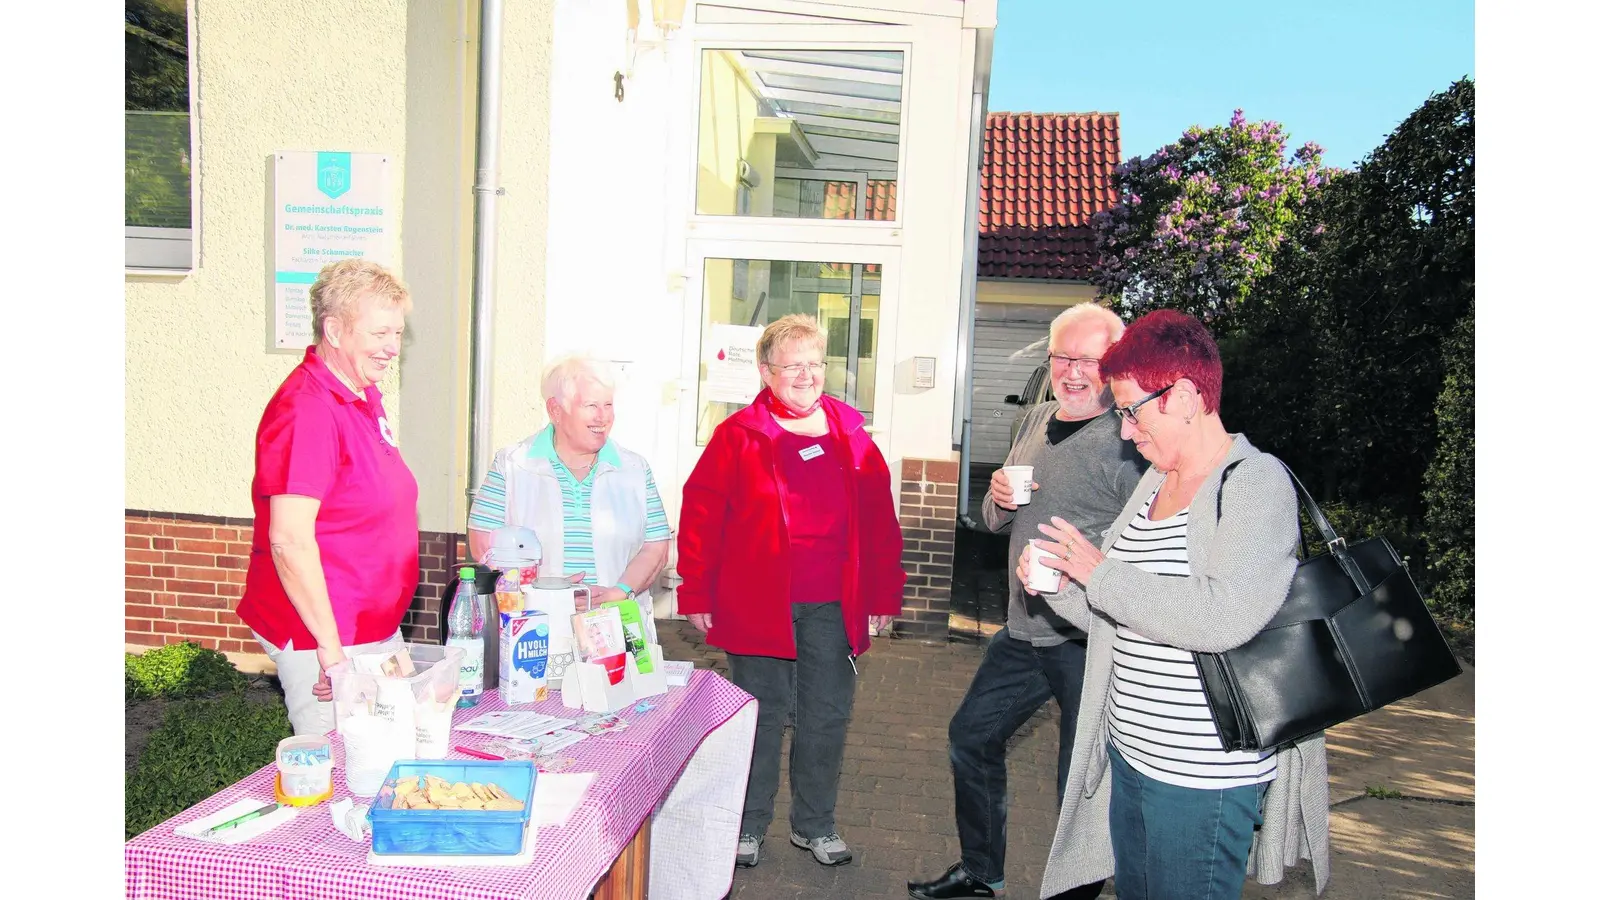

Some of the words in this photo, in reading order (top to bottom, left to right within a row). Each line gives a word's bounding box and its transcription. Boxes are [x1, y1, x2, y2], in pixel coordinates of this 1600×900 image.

[285, 204, 384, 217] Gemeinschaftspraxis
[285, 223, 295, 231] Dr.
[315, 224, 342, 232] Karsten
[303, 247, 320, 255] Silke
[321, 248, 364, 257] Schumacher
[517, 641, 528, 660] H
[528, 639, 548, 650] VOLL
[528, 648, 548, 658] MILCH
